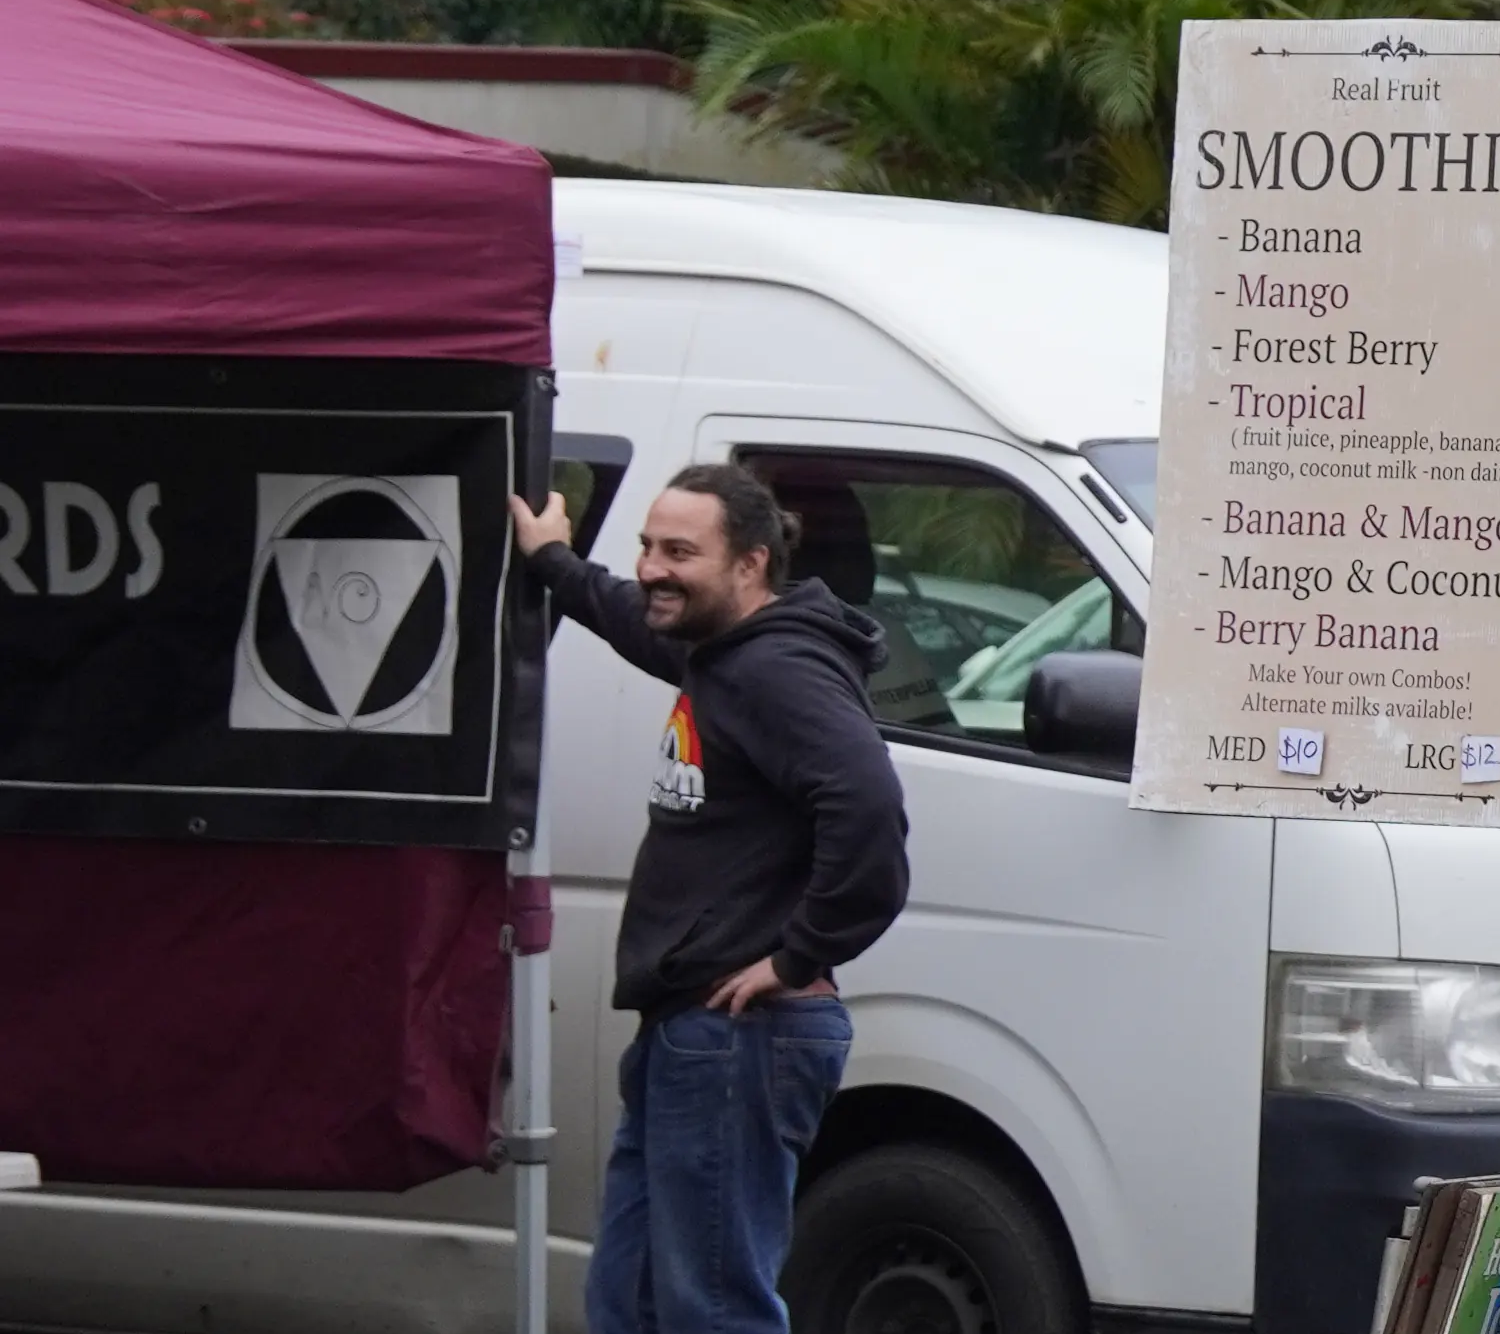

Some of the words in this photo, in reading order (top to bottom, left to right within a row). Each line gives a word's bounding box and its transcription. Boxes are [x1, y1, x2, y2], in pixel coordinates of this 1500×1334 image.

[1332, 77, 1380, 103] Real
[1387, 78, 1441, 103] Fruit
[1238, 219, 1362, 256] Banana
[1236, 275, 1350, 317] Mango
[1232, 330, 1338, 365] Forest
[1347, 333, 1439, 374] Berry
[1230, 385, 1367, 429] Tropical
[1285, 429, 1336, 454] juice,
[1340, 430, 1433, 456] pineapple,
[1229, 458, 1294, 483] mango,
[1299, 460, 1371, 480] coconut
[1375, 459, 1416, 482] milk
[1223, 500, 1346, 539] Banana
[1360, 504, 1388, 539] &
[1220, 556, 1332, 597] Mango
[1346, 561, 1374, 593] &
[1216, 612, 1306, 654] Berry
[1315, 616, 1440, 652] Banana
[1247, 664, 1297, 685] Make
[1302, 665, 1344, 686] Your
[1348, 671, 1387, 686] own
[1392, 668, 1471, 690] Combos!
[1241, 693, 1327, 714] Alternate
[1332, 694, 1380, 717] milks
[1385, 697, 1473, 721] available!
[1207, 735, 1266, 762] MED
[1279, 736, 1318, 765] $10
[1405, 743, 1456, 771] LRG
[1462, 743, 1500, 769] $12
